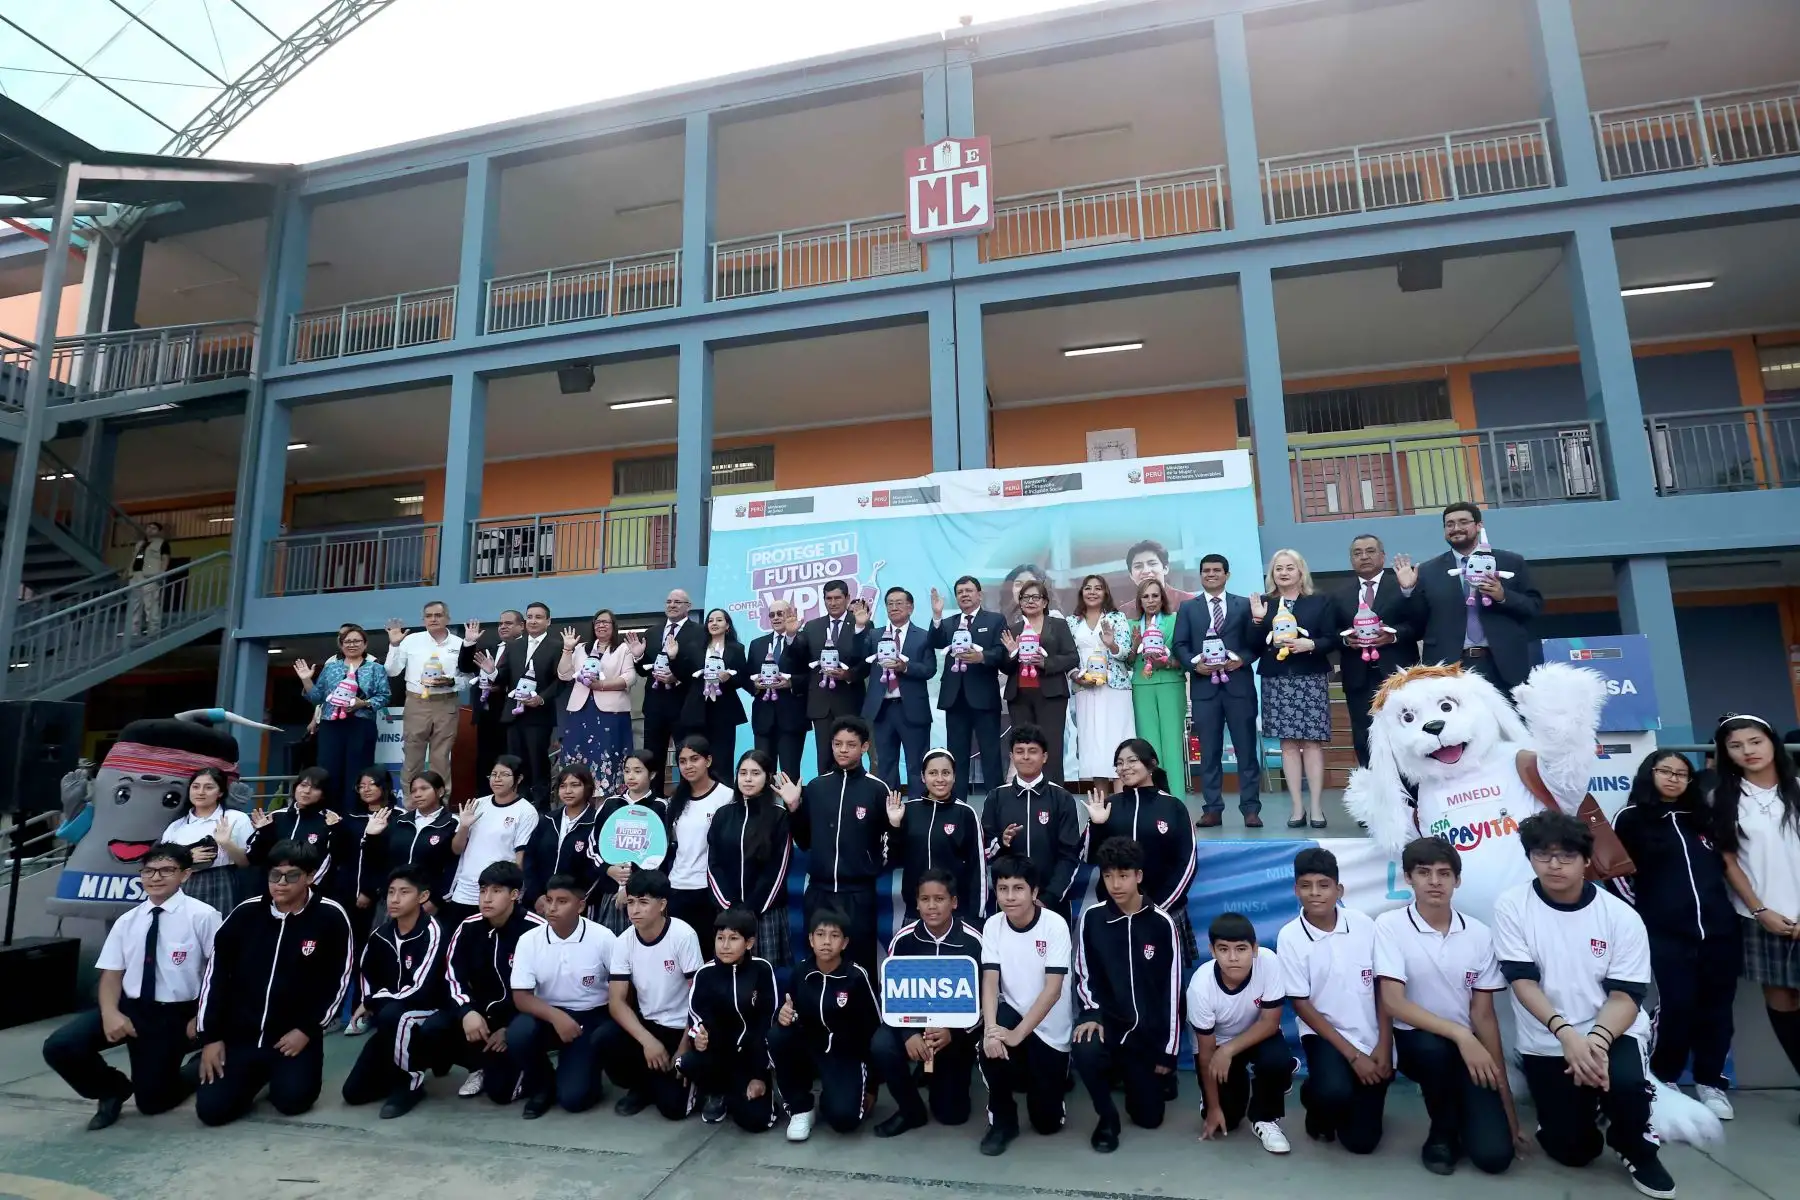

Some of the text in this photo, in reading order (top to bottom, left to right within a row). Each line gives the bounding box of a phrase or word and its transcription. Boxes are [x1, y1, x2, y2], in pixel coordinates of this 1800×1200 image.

[918, 149, 980, 171] I E
[918, 171, 981, 229] MC
[1146, 470, 1162, 478] PERÚ
[752, 538, 850, 567] PROTEGE TU
[764, 559, 842, 586] FUTURO
[728, 599, 764, 612] CONTRA
[748, 610, 761, 620] EL
[1446, 785, 1501, 806] MINEDU
[618, 835, 642, 849] VPH
[78, 874, 148, 900] MINS
[1223, 901, 1269, 913] MINSA
[886, 977, 974, 999] MINSA
